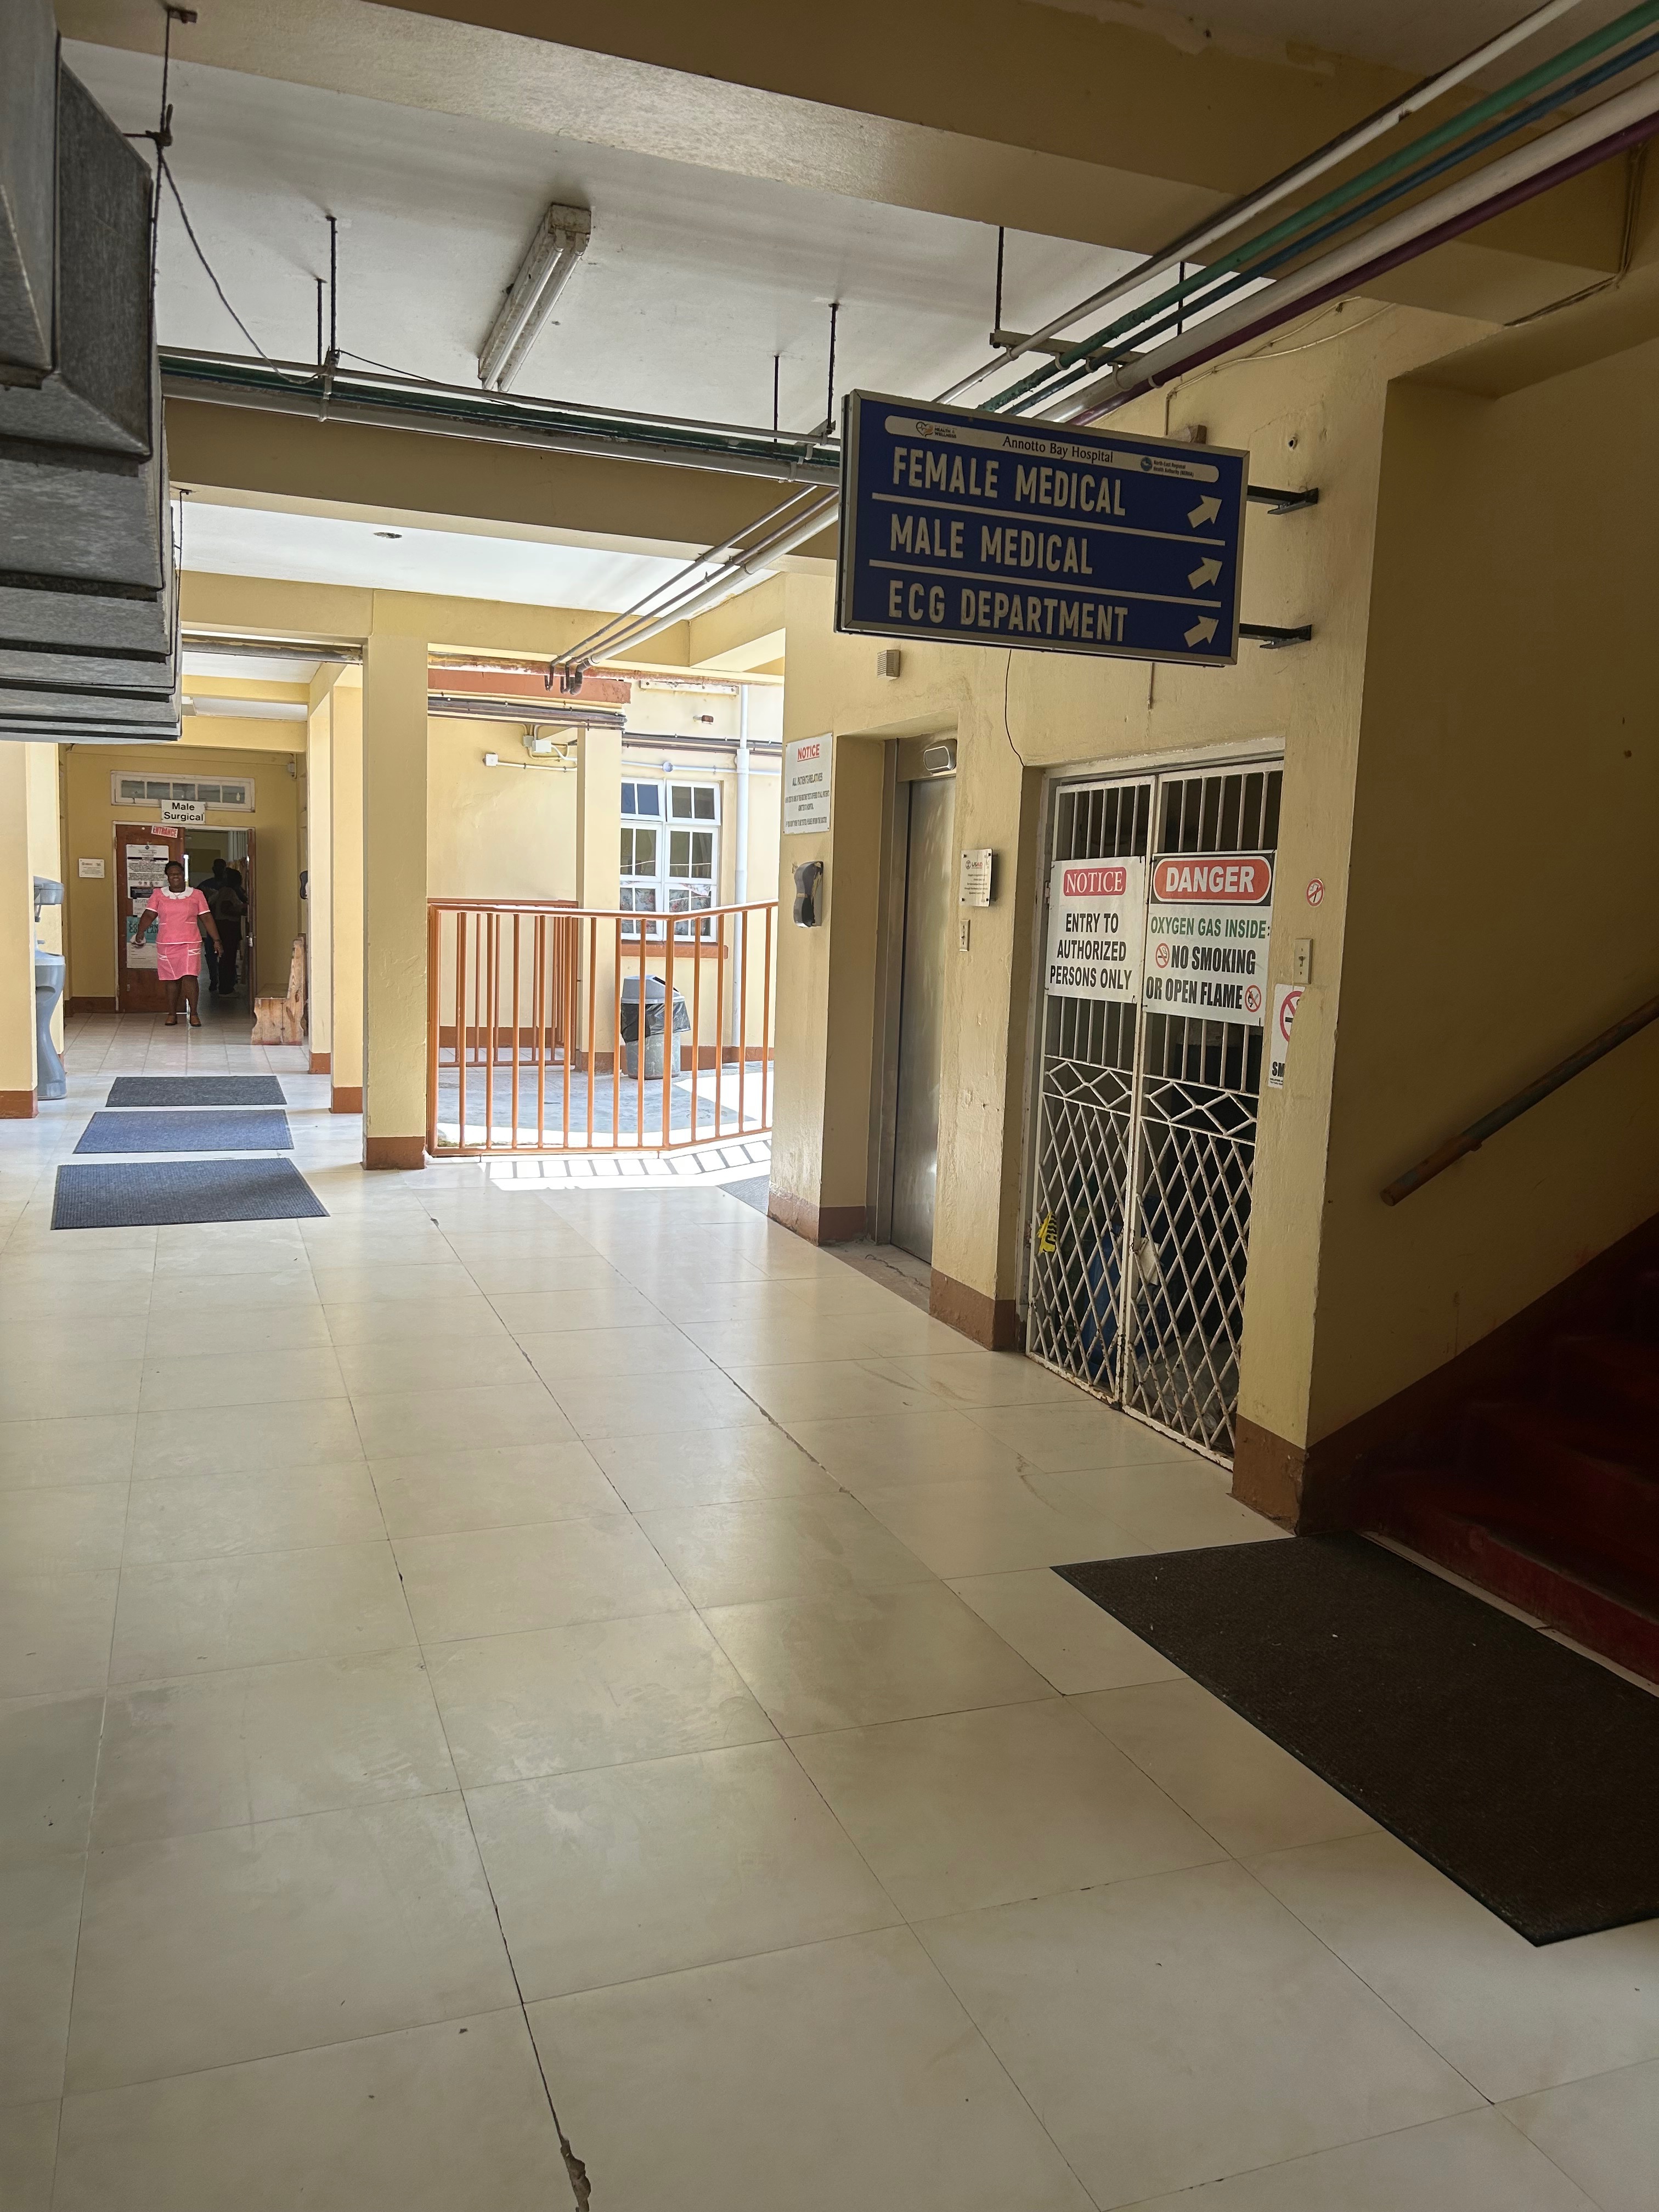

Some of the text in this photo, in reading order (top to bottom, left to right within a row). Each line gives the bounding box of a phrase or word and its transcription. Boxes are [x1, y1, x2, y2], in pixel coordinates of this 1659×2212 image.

[1002, 436, 1113, 464] Annotto Bay Hospital
[893, 446, 1125, 516] FEMALE MEDICAL
[890, 514, 1093, 574] MALE MEDICAL
[888, 579, 1128, 642] ECG DEPARTMENT
[797, 743, 820, 761] NOTICE
[164, 811, 204, 821] Surgical
[172, 802, 195, 811] Male
[154, 826, 177, 837] ENTRANCE
[1065, 871, 1123, 893] NOTICE
[1166, 866, 1255, 893] DANGER
[1065, 912, 1119, 933] ENTRY TO
[1151, 916, 1194, 935] OXYGEN
[1198, 918, 1221, 937] GAS
[1057, 939, 1127, 961] AUTHORIZED
[1171, 945, 1256, 975] NO SMOKING
[1049, 965, 1133, 990] PERSONS ONLY
[1146, 976, 1243, 1009] OR OPEN FLAME
